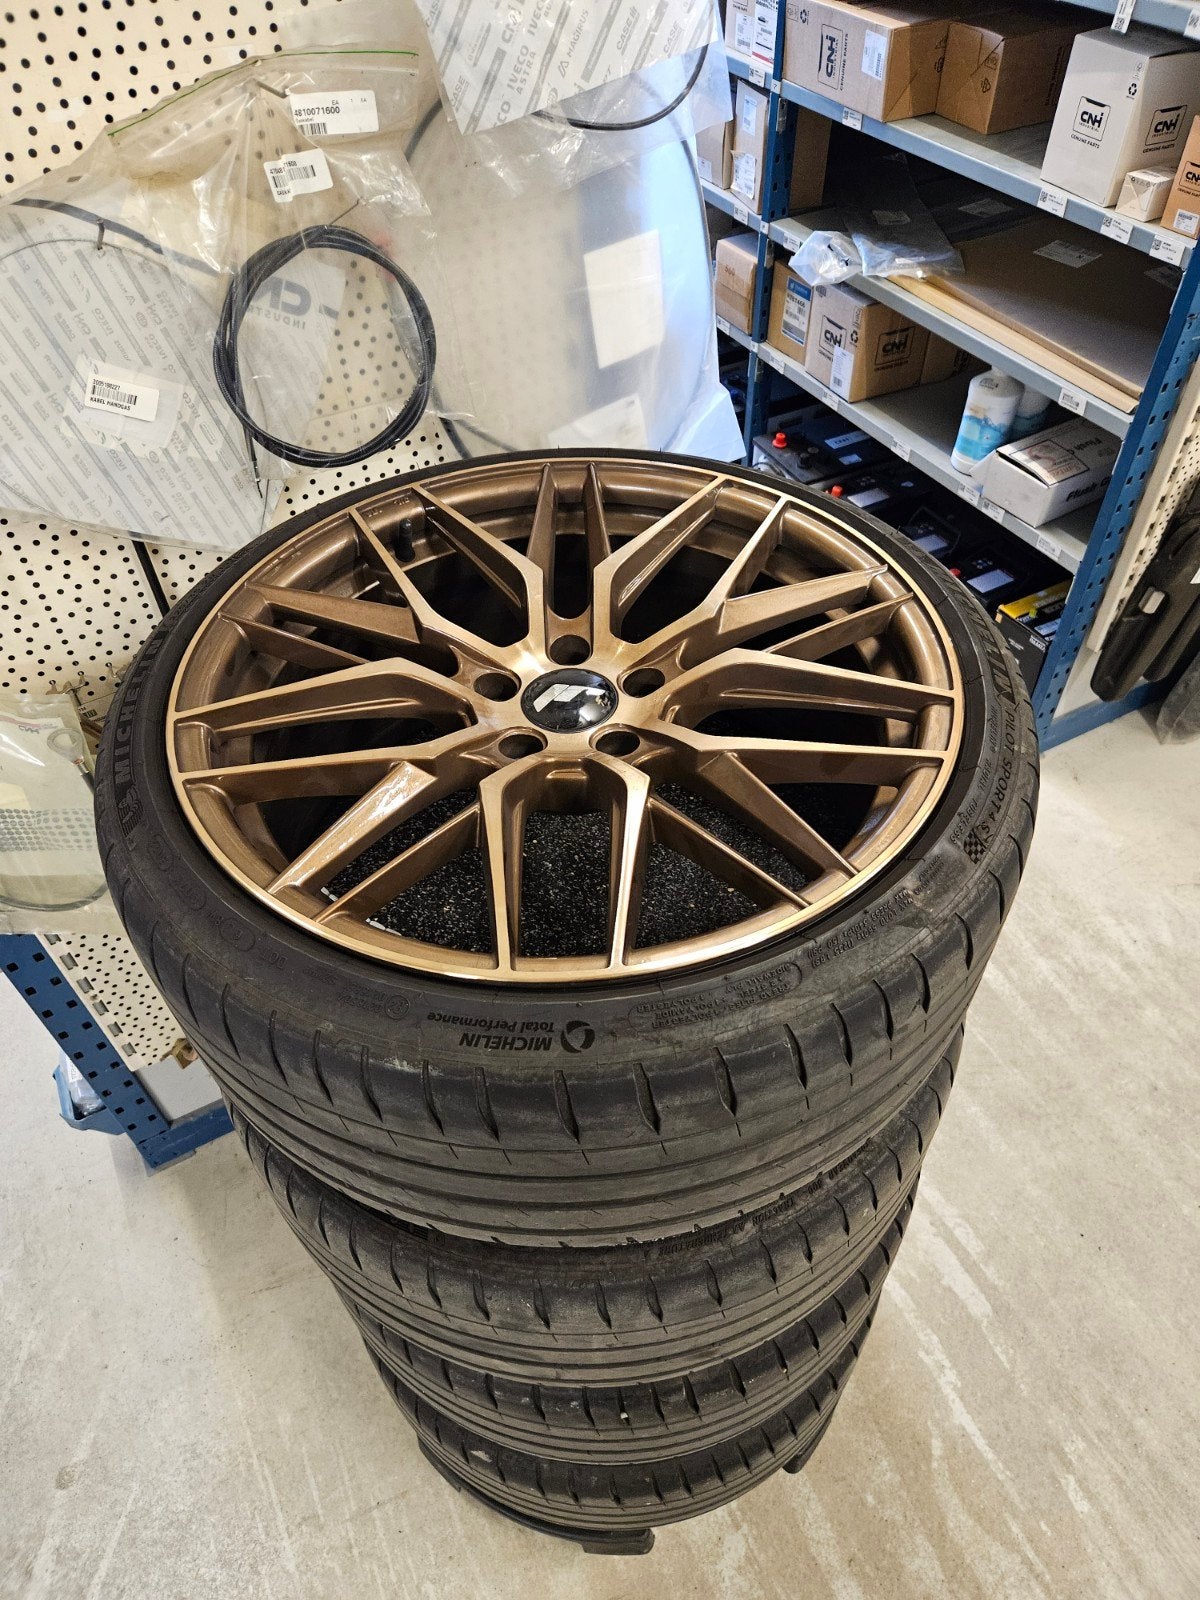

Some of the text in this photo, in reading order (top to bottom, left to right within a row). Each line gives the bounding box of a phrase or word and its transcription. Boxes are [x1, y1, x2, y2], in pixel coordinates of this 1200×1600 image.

[566, 9, 589, 58] MAGIRUS
[507, 45, 530, 91] IVECO
[1080, 110, 1105, 129] CNH
[1153, 112, 1181, 134] CNH
[1070, 133, 1100, 149] GENUINE PARTS
[1004, 708, 1016, 757] PILOT
[994, 758, 1013, 815] SPORT
[870, 901, 892, 919] PRESS
[426, 1011, 555, 1033] Total Performance
[459, 1032, 553, 1051] MICHELIN
